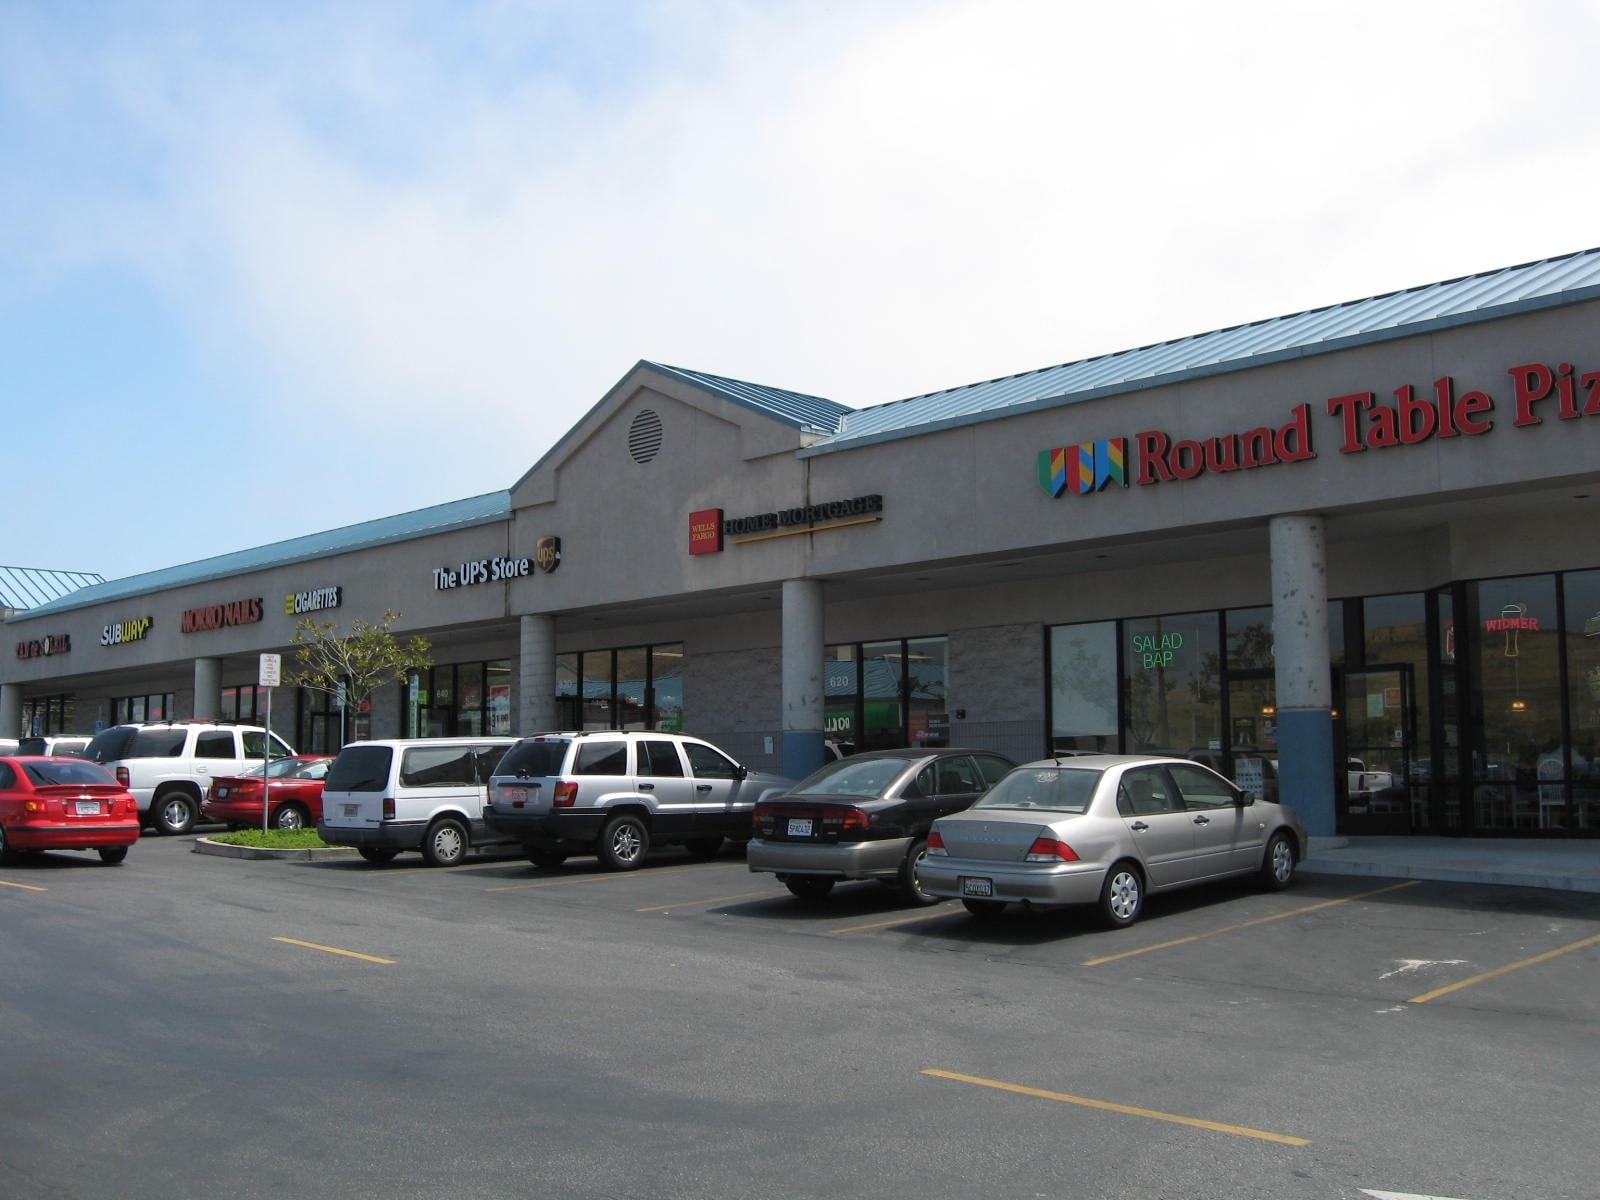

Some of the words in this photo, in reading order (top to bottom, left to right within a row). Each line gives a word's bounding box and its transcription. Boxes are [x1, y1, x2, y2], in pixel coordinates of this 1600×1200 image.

[1134, 403, 1316, 486] Round
[1327, 376, 1493, 455] Table
[691, 522, 715, 532] WELLS
[724, 513, 777, 535] HOME
[778, 494, 882, 526] MORTGAGE
[692, 531, 715, 541] FARGO
[433, 567, 457, 590] The
[460, 559, 488, 586] UPS
[491, 557, 530, 581] Store
[225, 598, 261, 625] NAILS
[295, 587, 338, 613] CIGARETTES
[101, 617, 150, 646] SUBWAY
[1486, 617, 1539, 632] WIDMER
[1133, 632, 1183, 653] SALAD
[830, 676, 849, 688] 620
